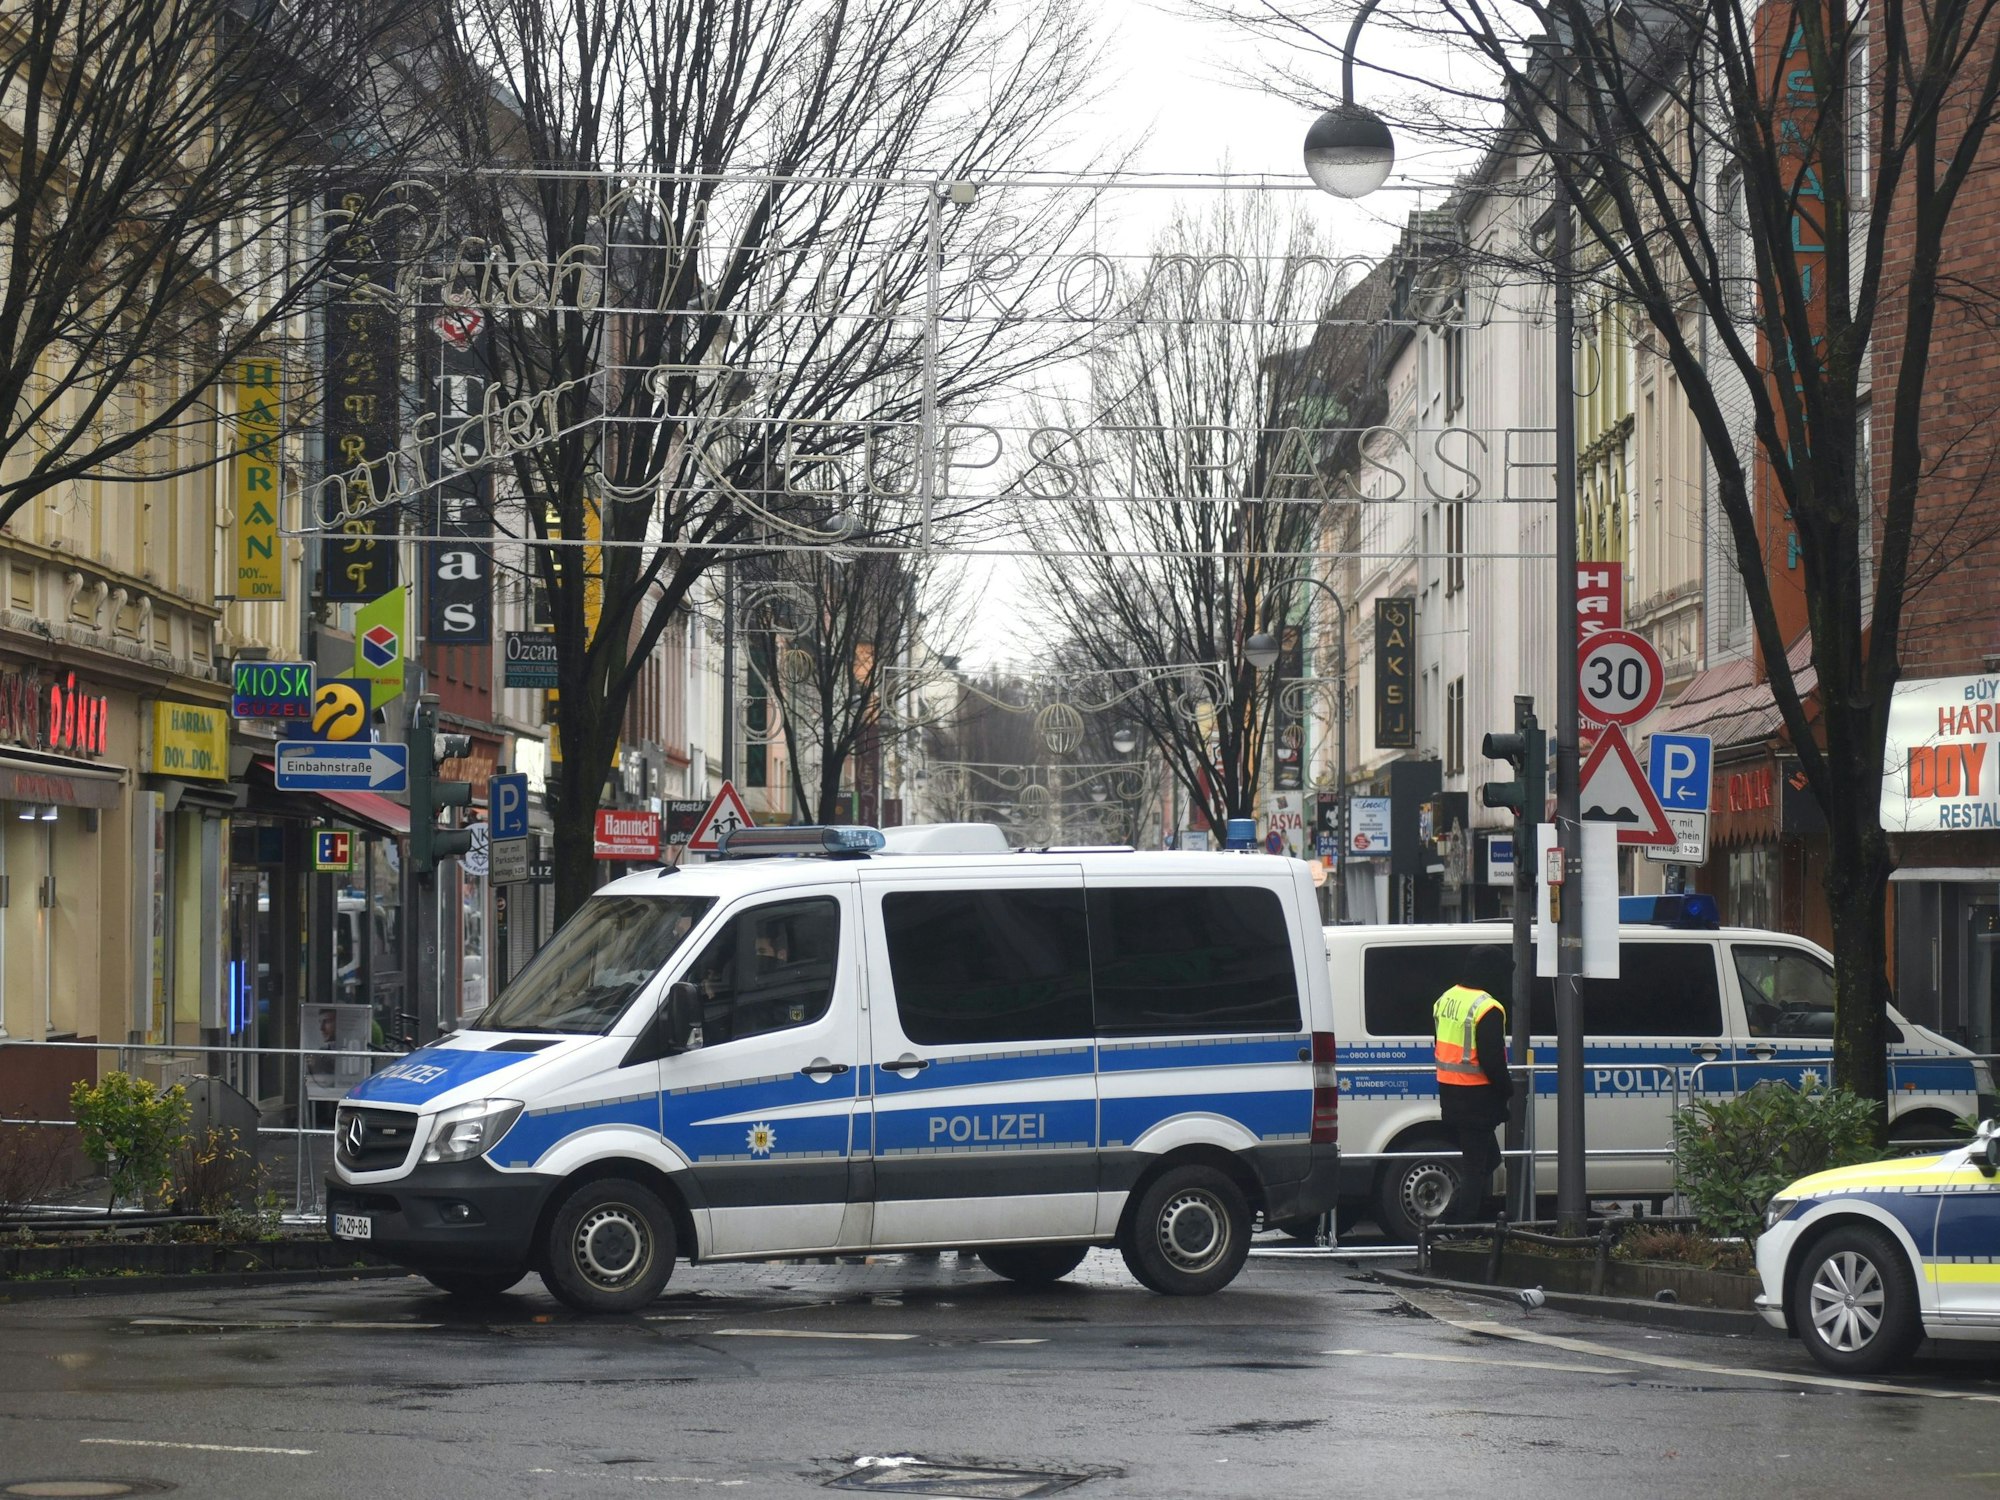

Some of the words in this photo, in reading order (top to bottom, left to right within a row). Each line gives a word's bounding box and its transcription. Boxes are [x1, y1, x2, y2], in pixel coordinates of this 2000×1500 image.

[243, 363, 275, 560] HARRAN
[507, 632, 558, 661] Özcan
[236, 667, 309, 697] KIOSK
[1588, 656, 1643, 700] 30
[171, 709, 214, 734] HARRAN
[236, 702, 310, 716] GÜZEL
[287, 760, 372, 773] Einbahnstraße
[1663, 744, 1696, 799] P
[1907, 742, 1987, 799] DOY
[500, 783, 519, 832] P
[1269, 813, 1302, 830] ASYA
[1441, 997, 1462, 1022] ZOLL
[368, 1064, 448, 1084] POLIZEI
[1593, 1064, 1704, 1091] POLIZEI
[928, 1113, 1045, 1142] POLIZEI
